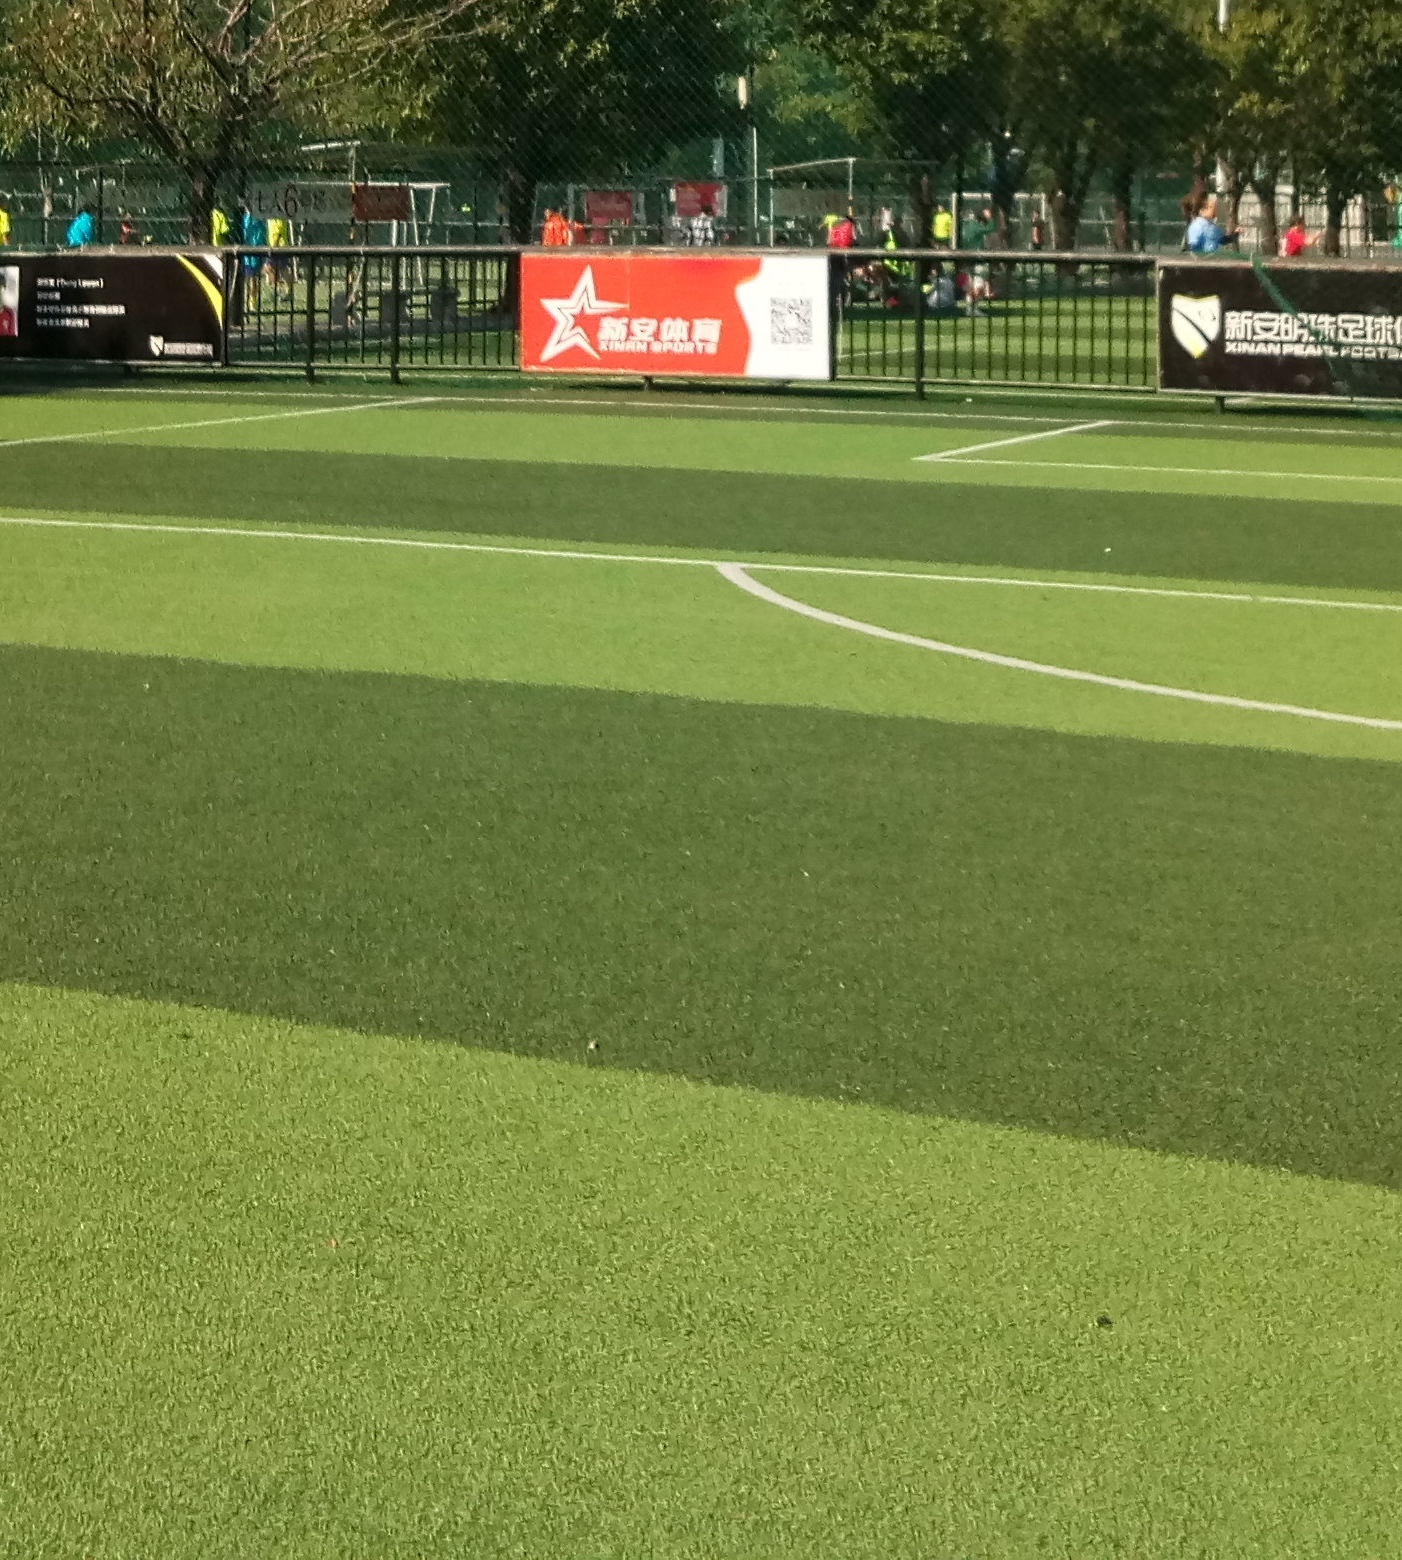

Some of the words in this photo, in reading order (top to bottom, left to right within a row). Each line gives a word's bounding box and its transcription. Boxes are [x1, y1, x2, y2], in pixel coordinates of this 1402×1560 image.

[597, 316, 723, 343] 新安体育
[1224, 341, 1282, 355] XINAN
